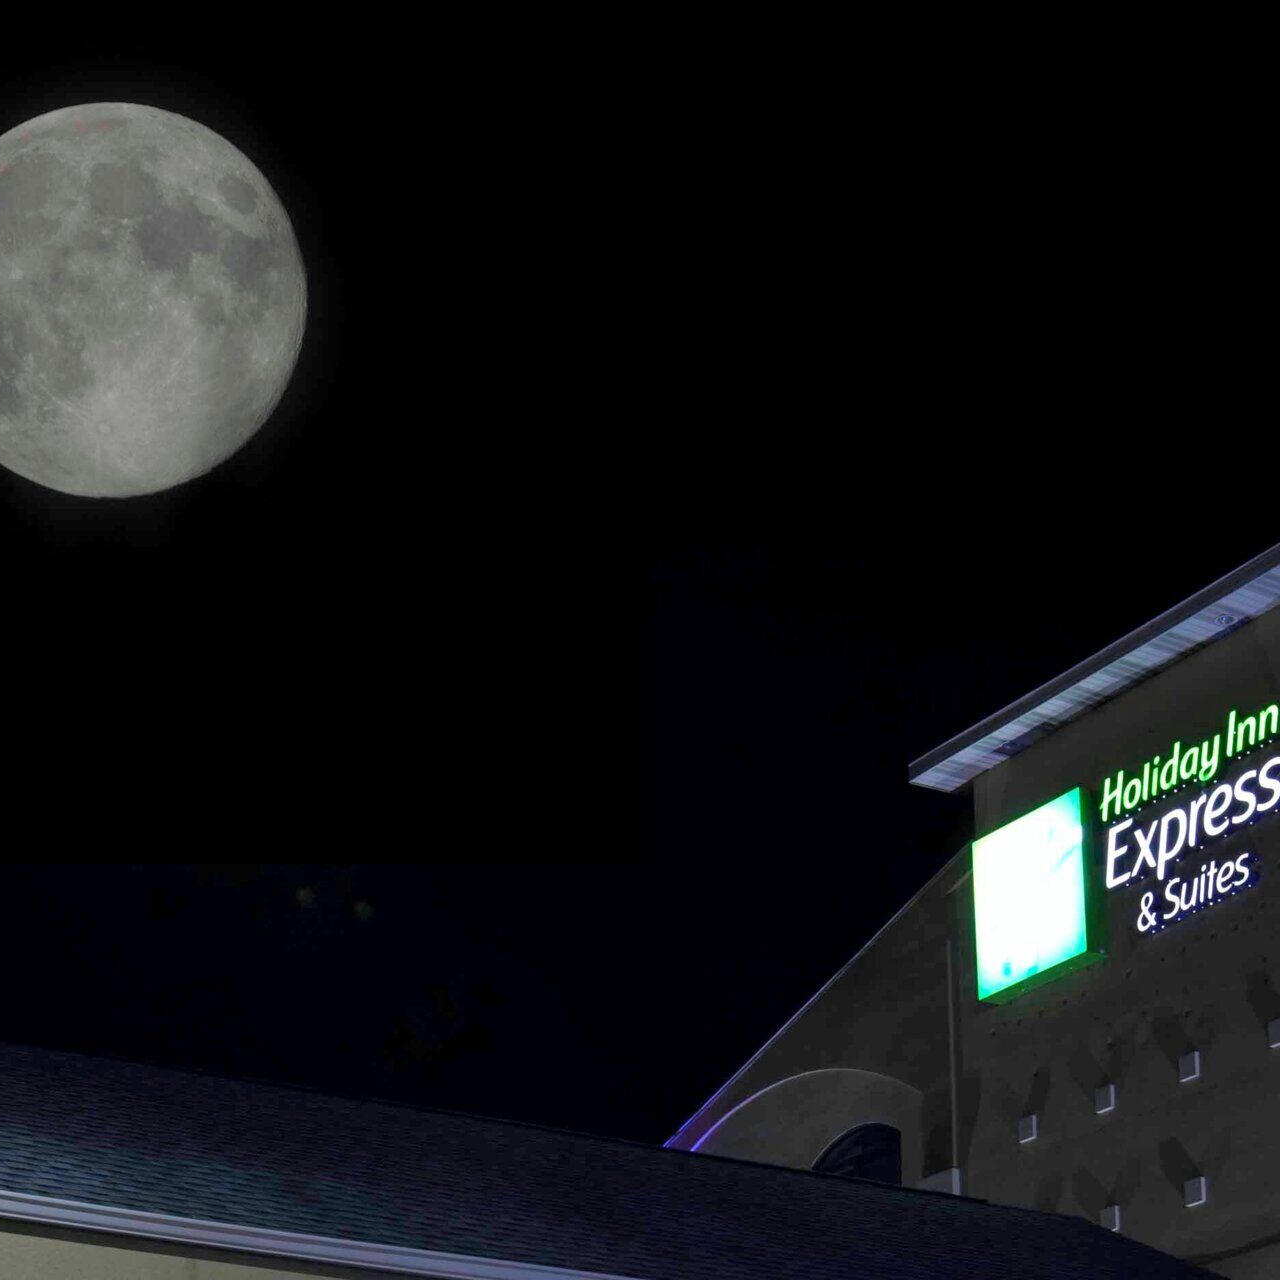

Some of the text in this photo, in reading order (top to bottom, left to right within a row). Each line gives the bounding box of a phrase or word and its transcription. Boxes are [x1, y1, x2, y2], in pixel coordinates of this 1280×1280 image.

[1100, 704, 1279, 822] Holiday Inn
[1136, 852, 1250, 932] & Suites
